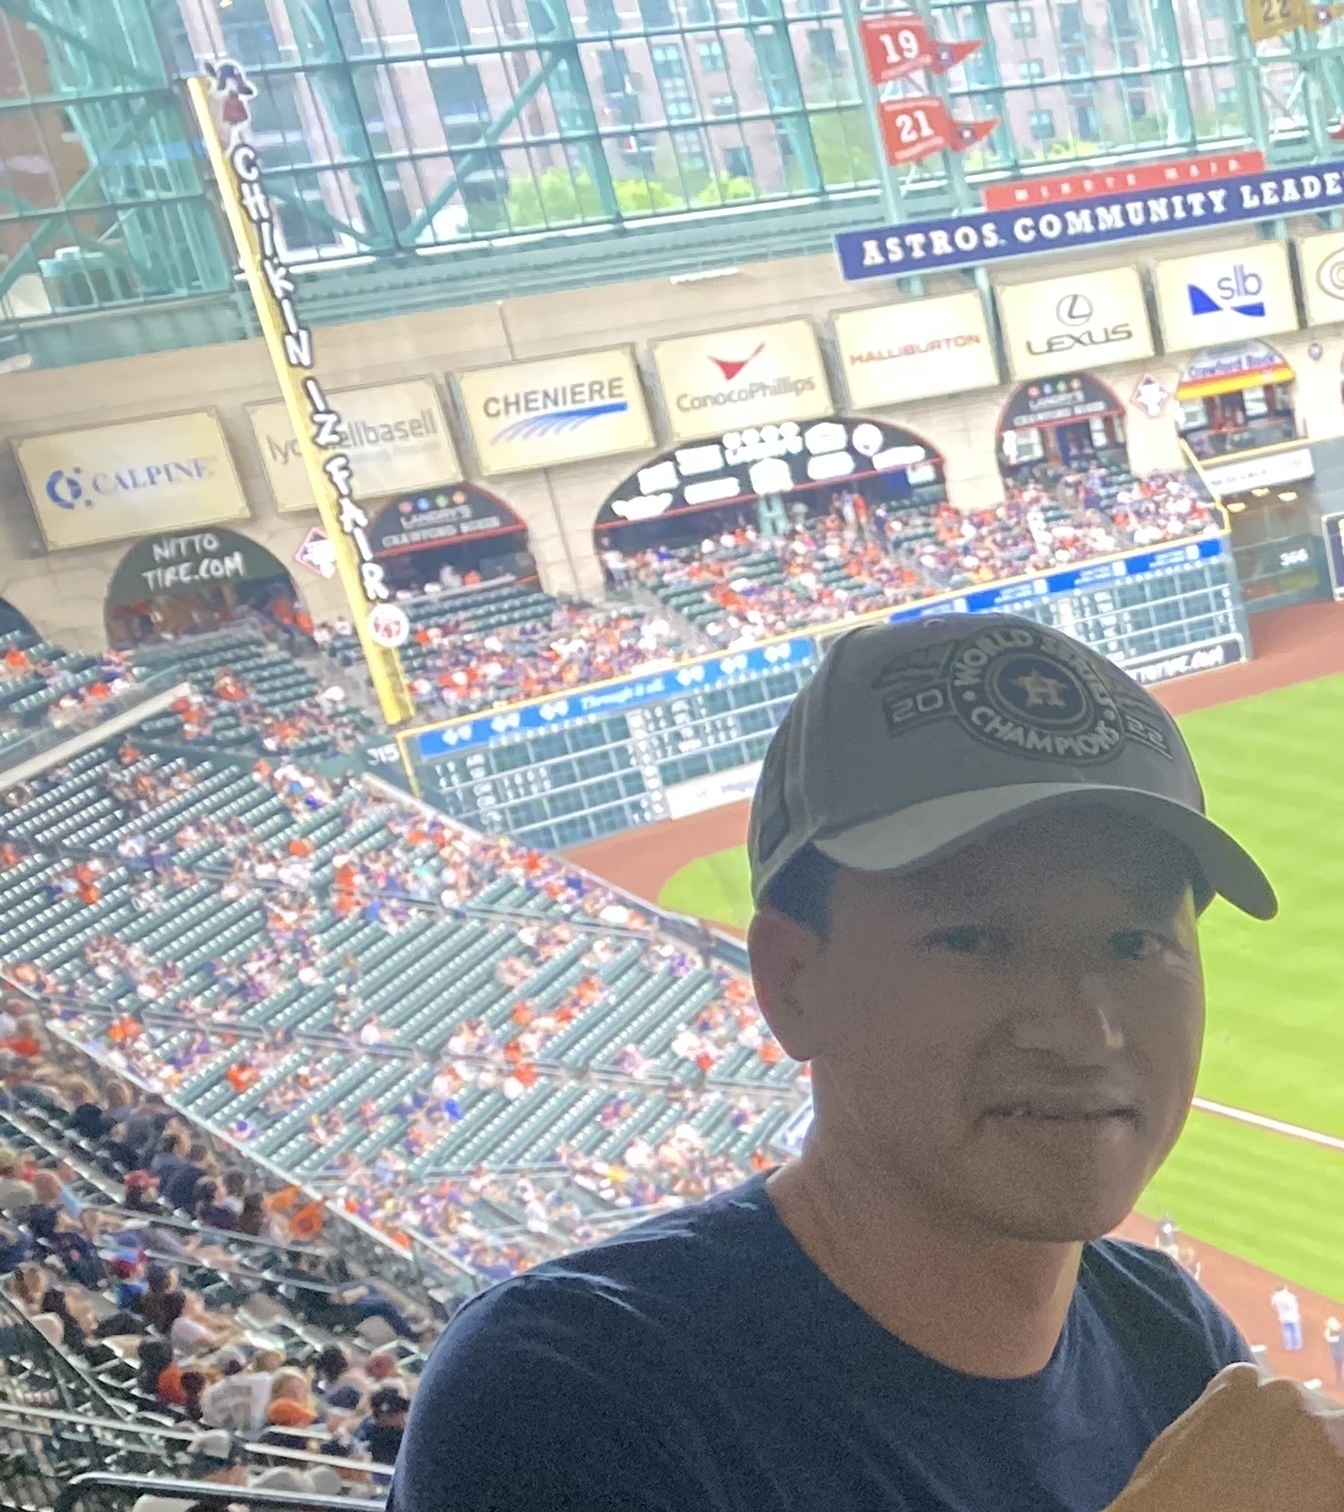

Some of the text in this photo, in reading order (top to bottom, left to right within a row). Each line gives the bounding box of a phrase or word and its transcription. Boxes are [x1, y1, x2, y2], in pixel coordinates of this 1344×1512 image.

[880, 30, 919, 64] 19
[896, 110, 934, 143] 21
[862, 222, 999, 266] ASTROS
[1013, 188, 1228, 242] COMMUNITY
[1217, 264, 1263, 300] slb
[850, 334, 981, 365] HALLIBURTON
[1025, 323, 1133, 356] LEXUS
[233, 145, 390, 600] CHIKIN IZ FAIR
[482, 377, 625, 418] CHENIERE
[675, 375, 815, 412] ConocoPhillips
[266, 408, 438, 464] lyoellbasell
[92, 457, 214, 495] CALPINE
[152, 533, 219, 563] NITTO
[141, 551, 245, 590] TIRE.COM
[954, 629, 1112, 711] WORLD SERIES
[891, 688, 945, 723] 20
[971, 706, 1120, 756] CHAMPIONS
